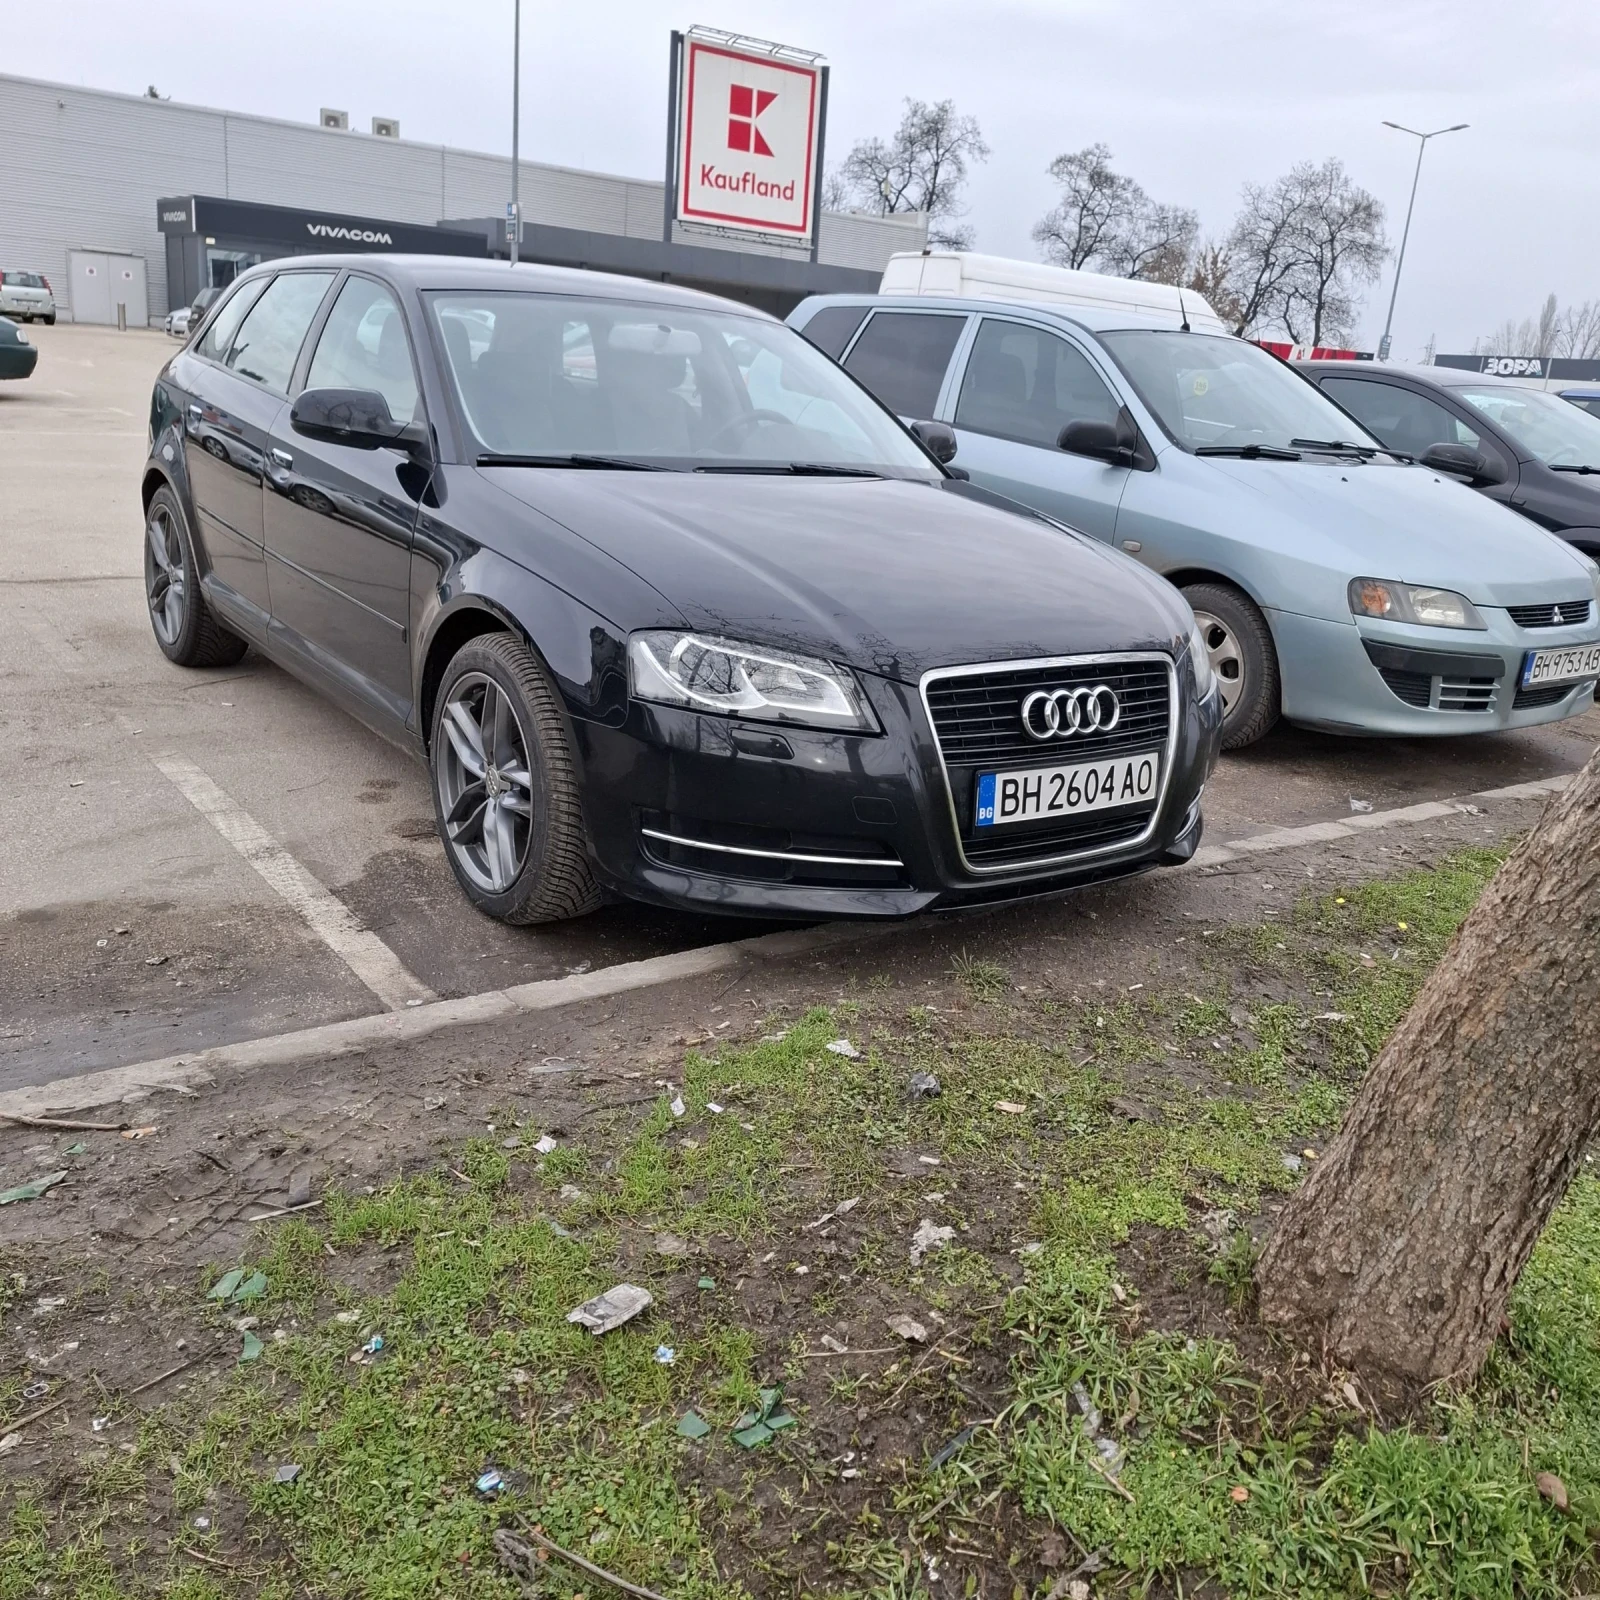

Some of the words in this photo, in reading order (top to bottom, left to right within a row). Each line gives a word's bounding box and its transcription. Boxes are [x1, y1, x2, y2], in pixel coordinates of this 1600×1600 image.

[701, 164, 795, 201] Kaufland
[306, 223, 392, 245] VIVACOM
[1484, 358, 1543, 376] ЗОРА
[1532, 654, 1554, 679] BH
[1553, 651, 1584, 676] 9753
[1583, 649, 1600, 672] AB
[1000, 775, 1042, 817] BH
[1047, 765, 1115, 811] 2604
[1120, 759, 1152, 799] AO
[979, 806, 993, 820] BG
